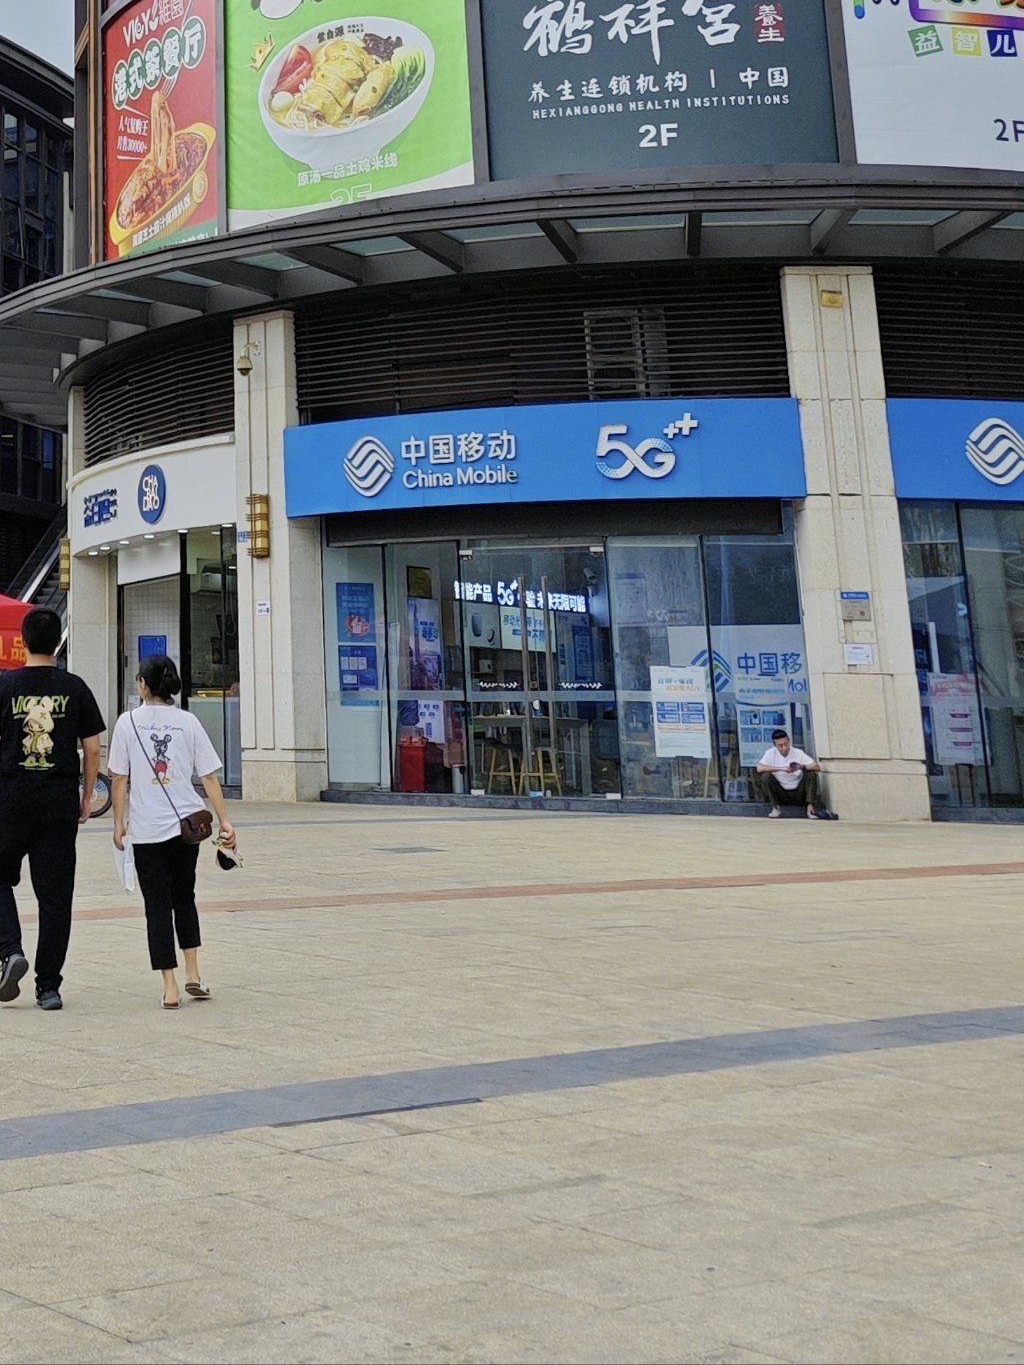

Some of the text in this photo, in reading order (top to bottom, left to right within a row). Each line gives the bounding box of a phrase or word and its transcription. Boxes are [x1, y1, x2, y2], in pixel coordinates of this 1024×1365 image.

[528, 67, 789, 104] 养生连锁机构 中国
[532, 94, 790, 120] HEXIANGGONG HEALTH INSTITUTIONS
[638, 123, 679, 148] 2F
[401, 430, 517, 466] 中国移动
[142, 474, 158, 491] CHA
[402, 466, 518, 490] China Mobile
[142, 494, 160, 512] DAO
[737, 652, 803, 675] 中国移
[11, 695, 70, 714] VICRY
